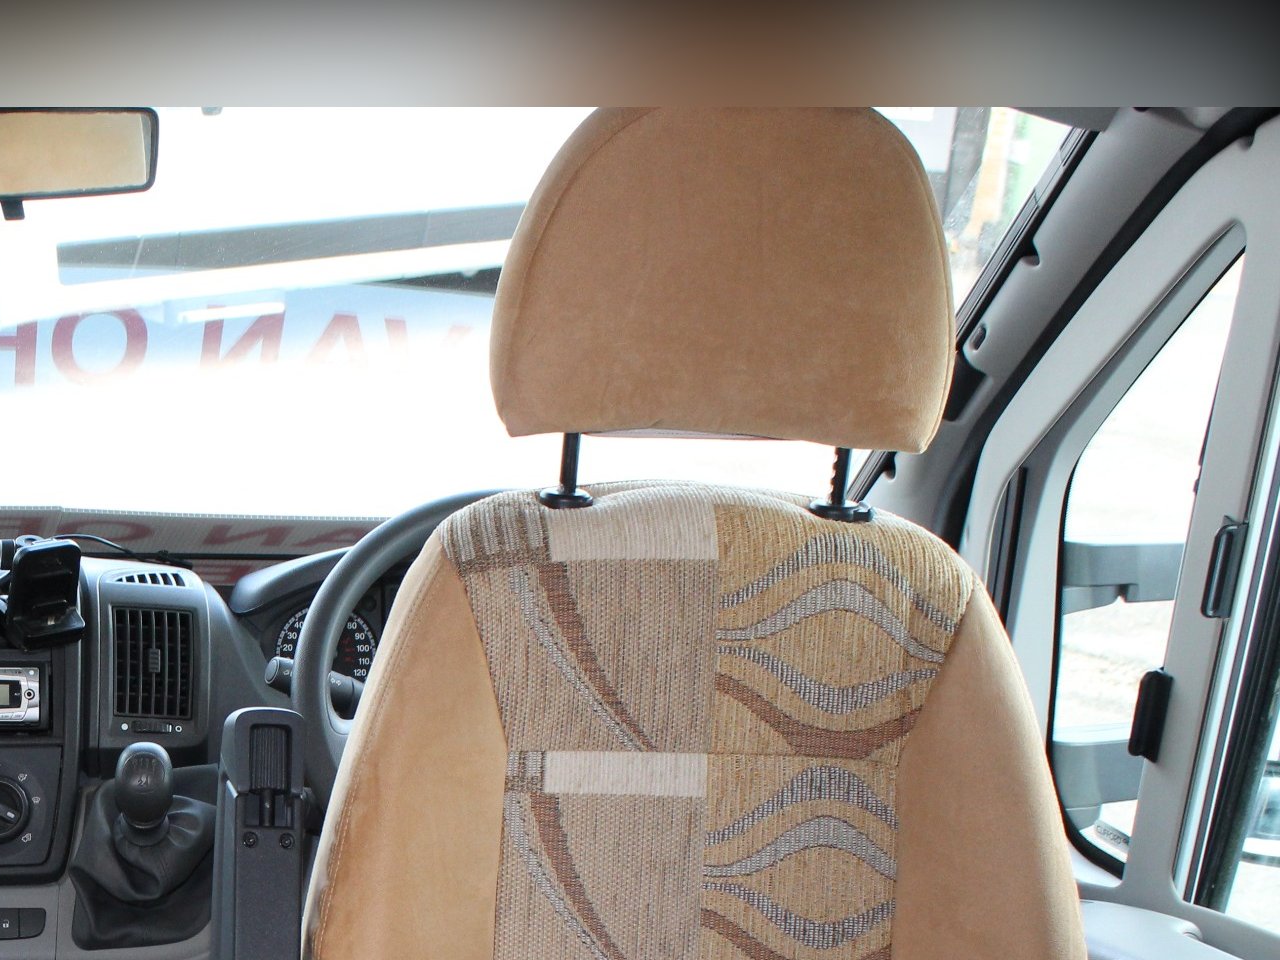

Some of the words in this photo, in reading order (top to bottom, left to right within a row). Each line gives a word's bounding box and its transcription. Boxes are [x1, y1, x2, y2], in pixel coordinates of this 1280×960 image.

[347, 622, 357, 630] 80
[287, 632, 298, 640] 30
[282, 644, 293, 652] 20
[356, 644, 370, 652] 100
[358, 657, 370, 665] 110
